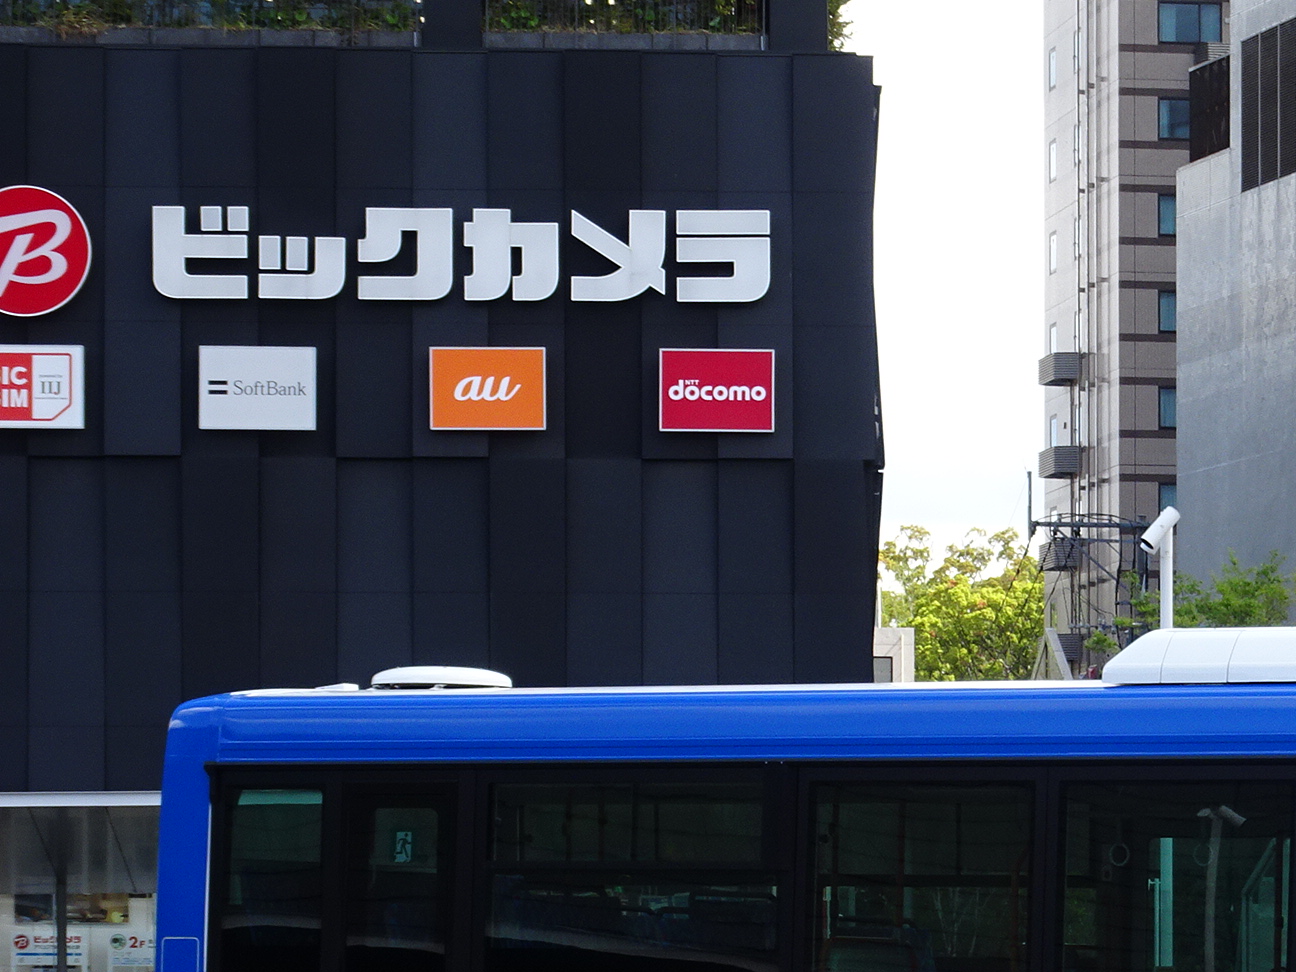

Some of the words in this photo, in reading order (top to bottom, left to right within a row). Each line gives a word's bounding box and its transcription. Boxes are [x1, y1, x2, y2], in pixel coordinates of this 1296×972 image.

[152, 205, 771, 302] ビックカメラ
[0, 366, 28, 385] IC
[0, 388, 28, 407] IM
[40, 381, 62, 395] IIJ
[233, 380, 307, 396] SoftBank
[453, 375, 521, 402] au
[668, 379, 767, 401] docomo
